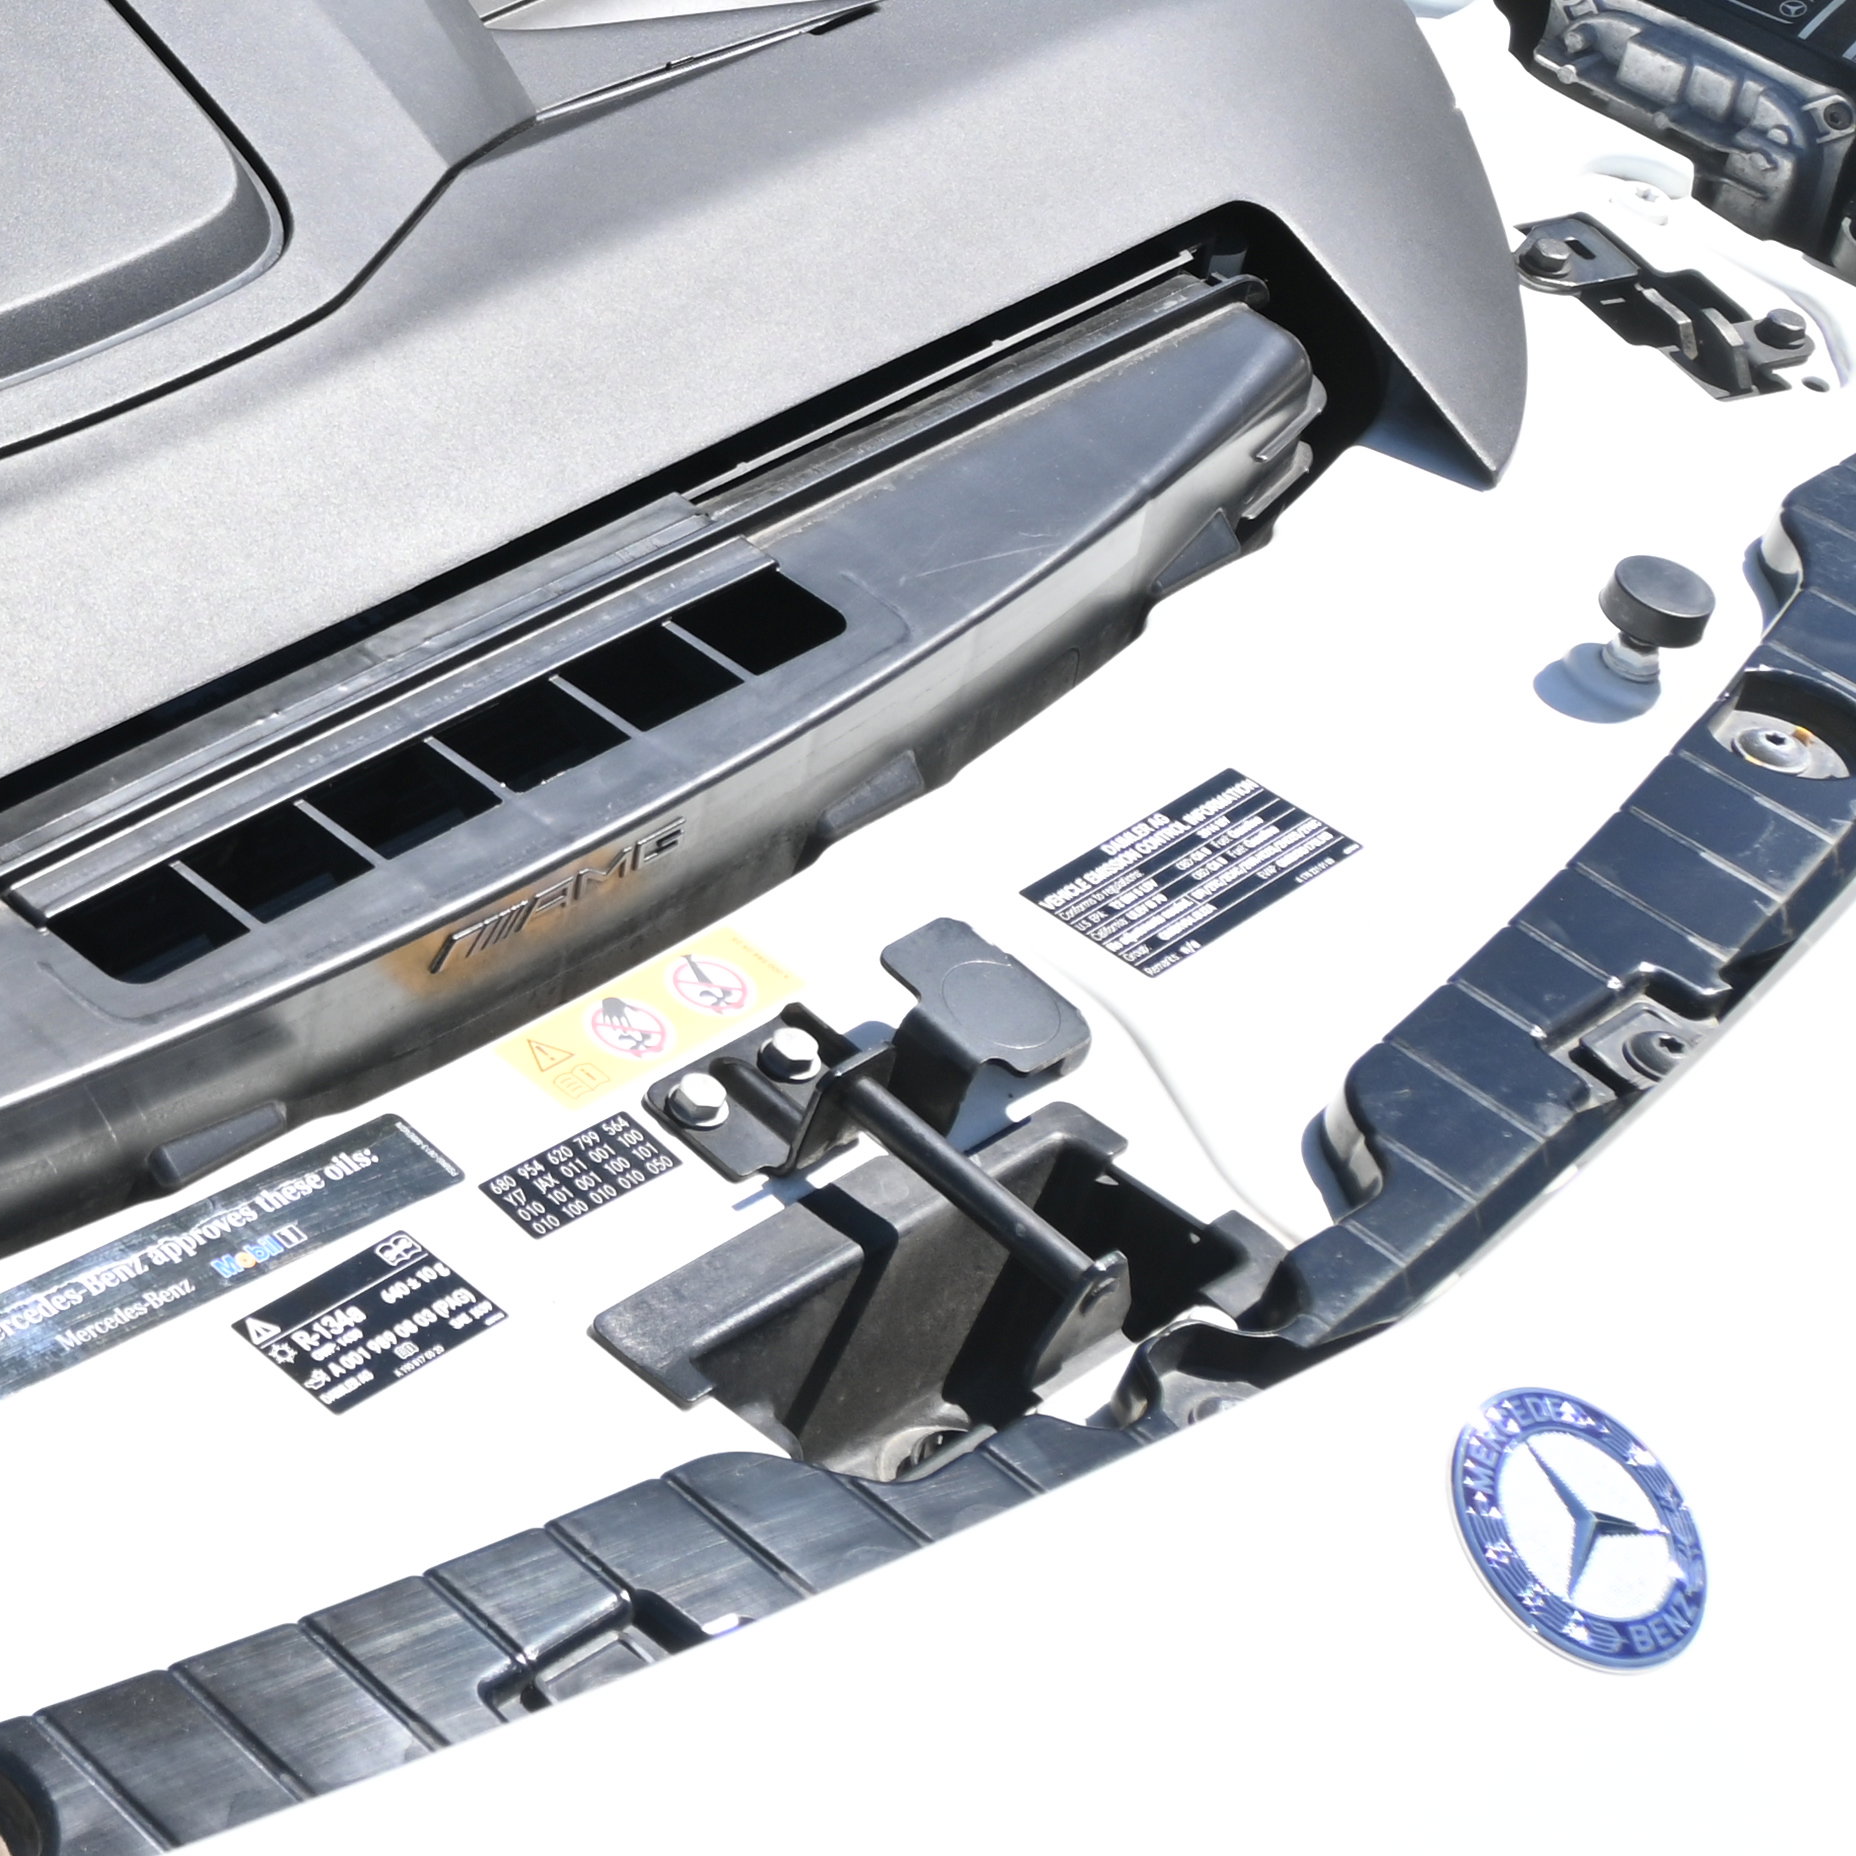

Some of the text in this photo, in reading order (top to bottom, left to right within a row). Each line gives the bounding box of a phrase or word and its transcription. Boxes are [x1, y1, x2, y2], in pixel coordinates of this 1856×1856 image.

[1039, 779, 1259, 910] VEHICLE EMISSION CONTROL INFORMATION
[490, 1116, 629, 1194] 680 954 620 799 564
[503, 1129, 644, 1206] YJ7 JAX 011 001 100
[517, 1142, 658, 1221] 010 101 001 100 101
[532, 1155, 673, 1234] 010 100 010 010 050
[141, 1201, 258, 1265] approves
[250, 1172, 325, 1212] these
[318, 1148, 379, 1180] oils:
[53, 1279, 195, 1352] Mercedes-Benz
[210, 1235, 284, 1278] Mobil
[291, 1306, 366, 1351] R-134a
[416, 1266, 438, 1283] 10
[328, 1362, 346, 1377] A
[339, 1346, 371, 1369] 001
[431, 1288, 476, 1318] (PAG)
[1627, 1592, 1700, 1654] BENZ
